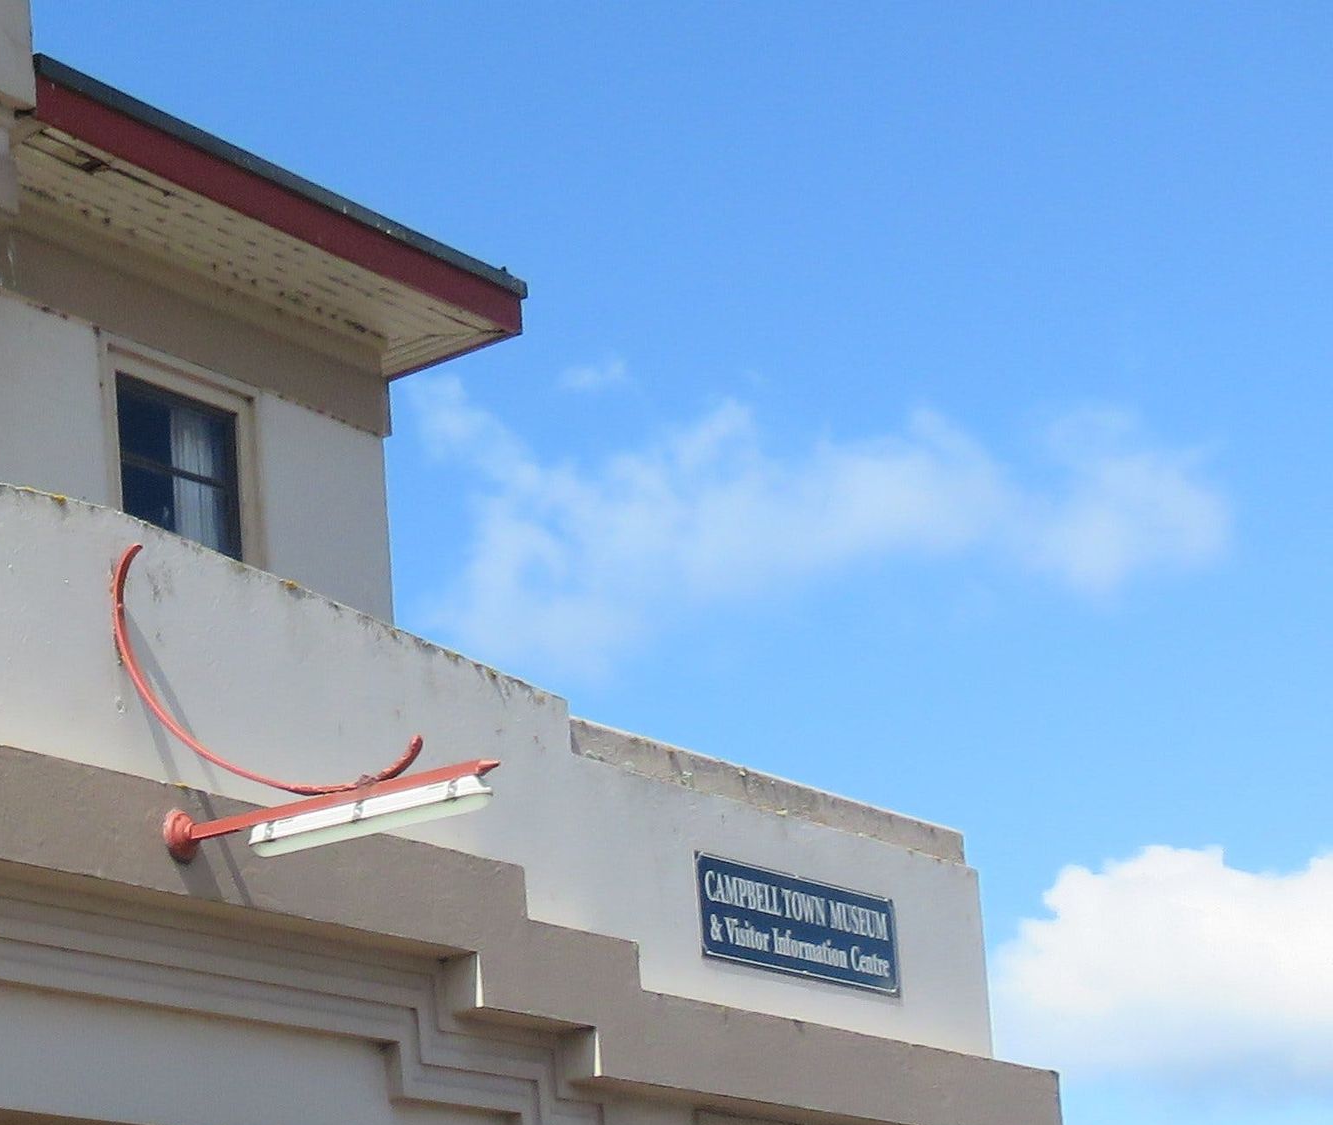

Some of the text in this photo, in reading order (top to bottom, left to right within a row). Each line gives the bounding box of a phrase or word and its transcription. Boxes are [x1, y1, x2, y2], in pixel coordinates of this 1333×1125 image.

[704, 869, 889, 942] CAMPBELL TOWN MUSEUM
[709, 913, 891, 978] & Visitor Information Centre
